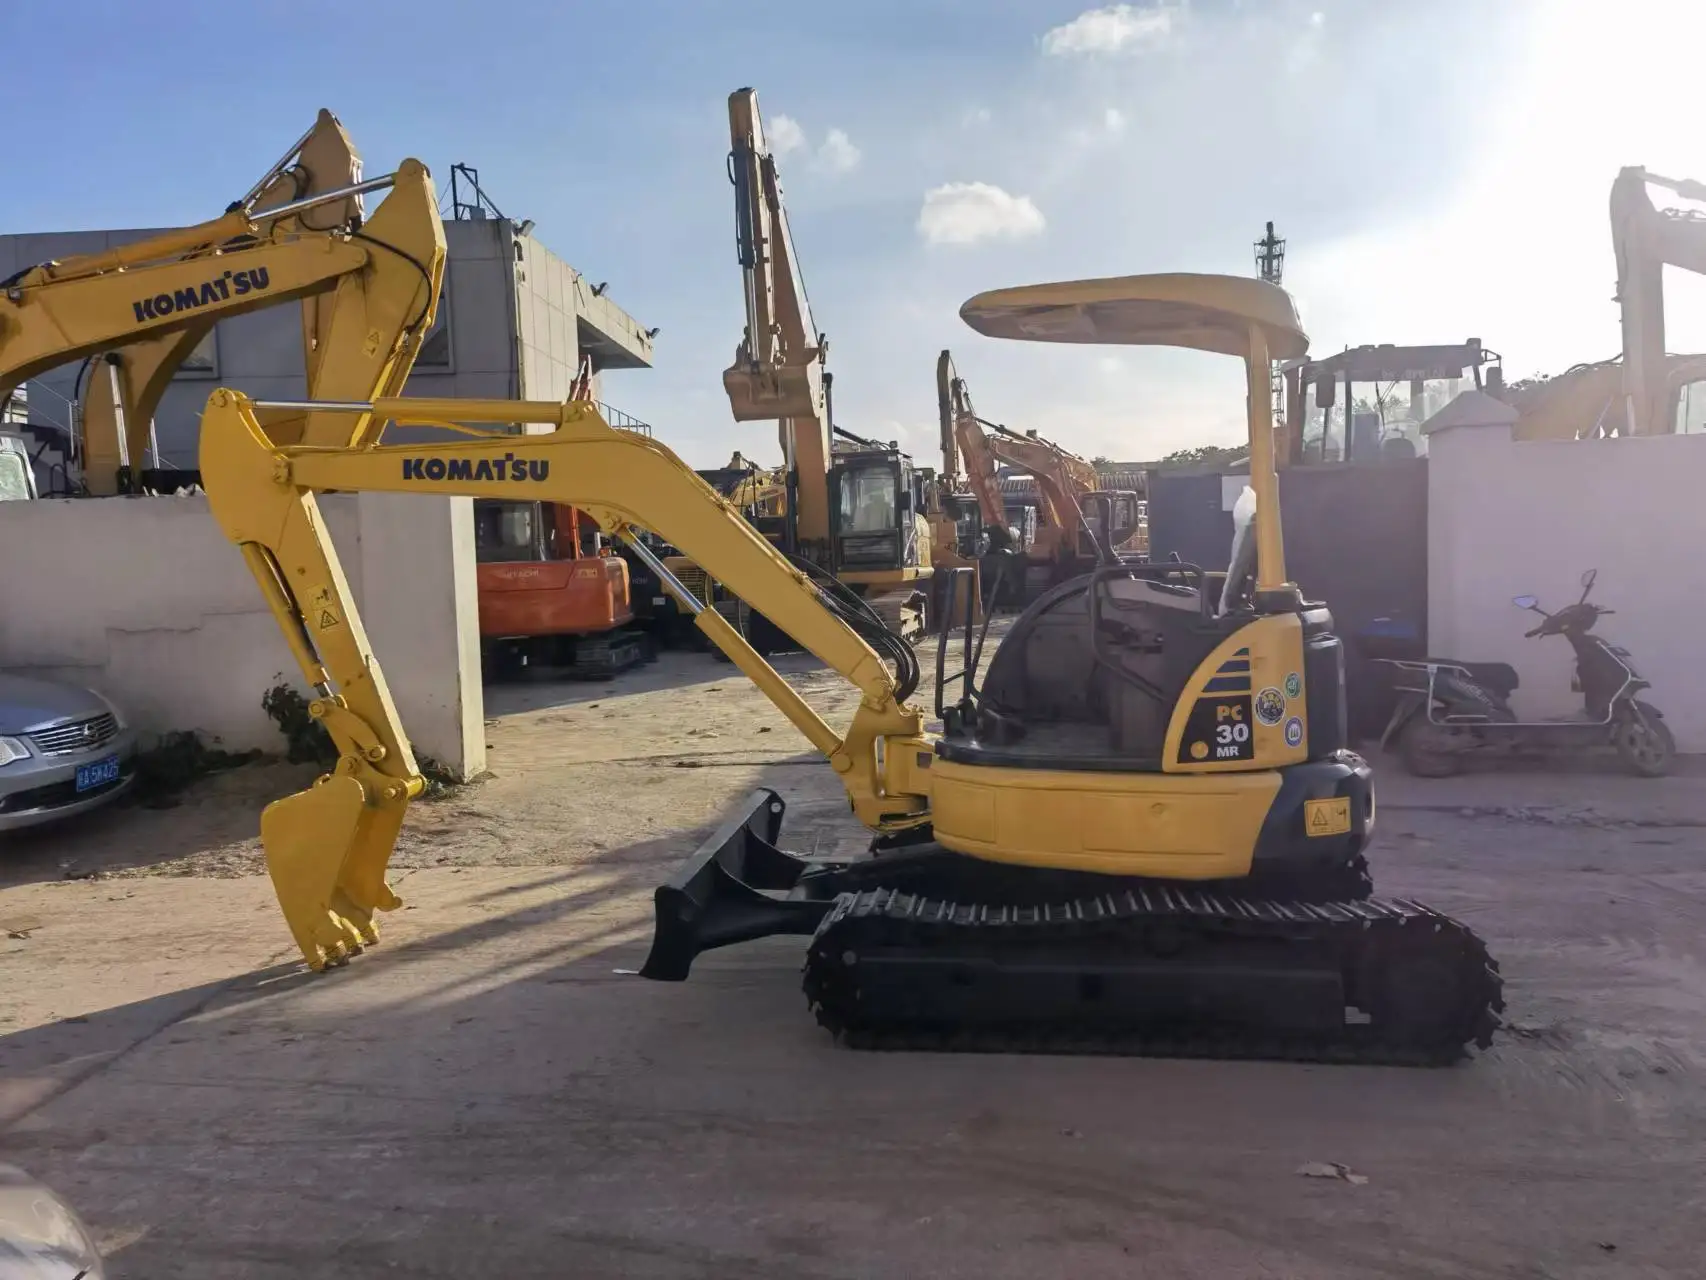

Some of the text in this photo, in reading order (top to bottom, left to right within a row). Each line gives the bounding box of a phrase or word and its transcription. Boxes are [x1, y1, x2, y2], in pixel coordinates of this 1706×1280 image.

[132, 266, 270, 323] KOMATSU
[402, 452, 549, 482] KOMATSU
[1216, 704, 1243, 721] PC
[1216, 723, 1249, 744] 30
[1216, 745, 1240, 758] MR
